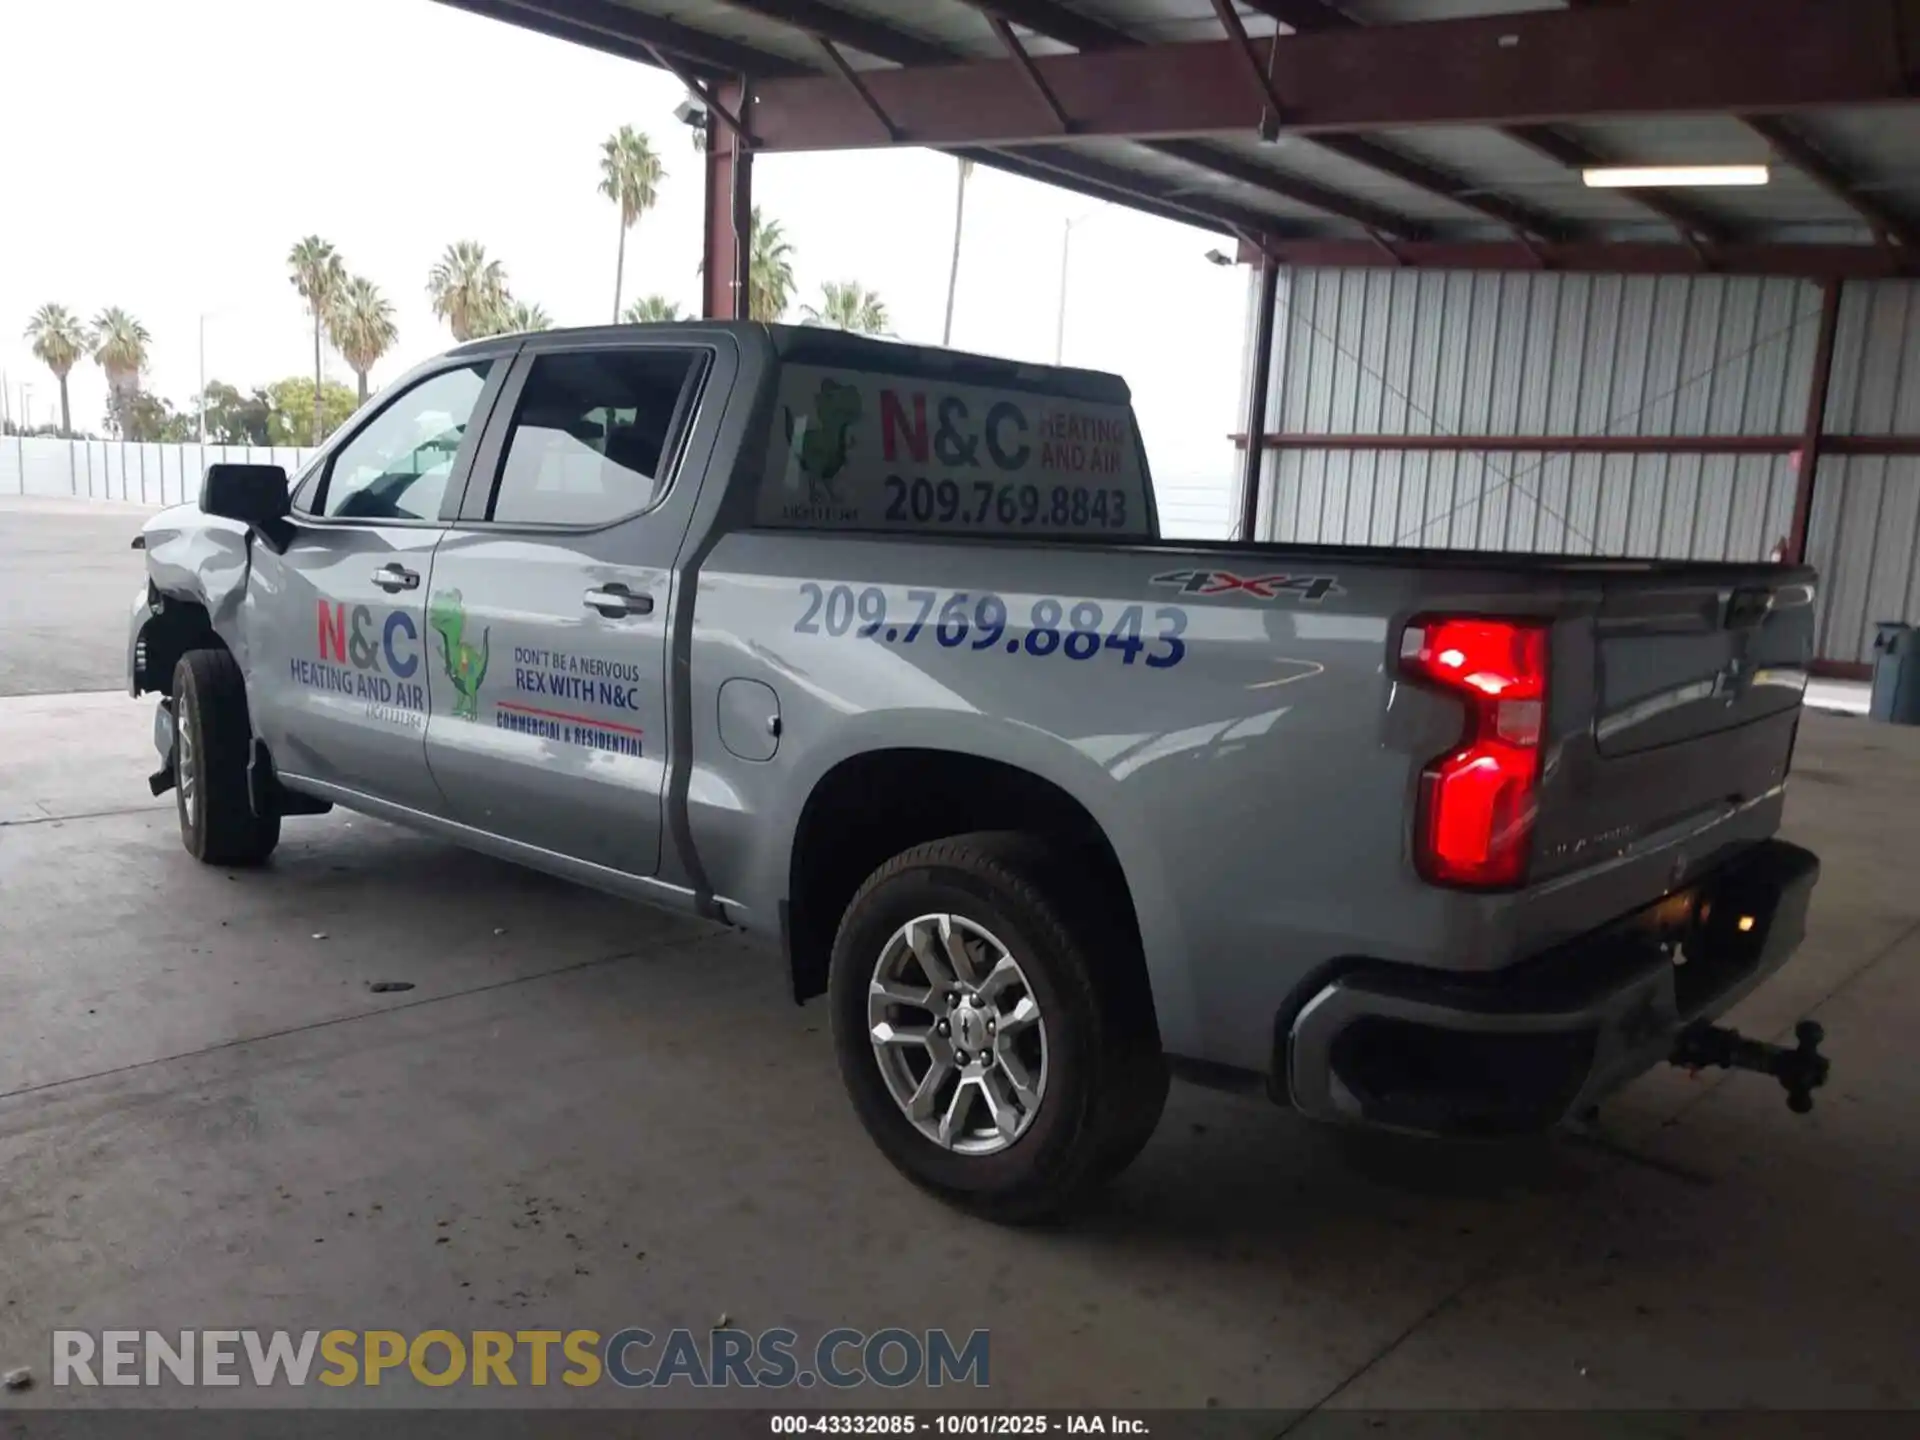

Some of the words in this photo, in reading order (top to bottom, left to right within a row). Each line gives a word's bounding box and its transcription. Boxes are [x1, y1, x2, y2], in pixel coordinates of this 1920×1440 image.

[878, 389, 1031, 470] N&C
[1040, 411, 1124, 444] HEATING
[1041, 441, 1084, 472] AND
[1089, 444, 1121, 474] AIR
[883, 476, 1126, 528] 209.769.8843
[317, 599, 418, 678] N&C
[793, 582, 1188, 668] 209.769.8843
[290, 658, 353, 695] HEATING
[356, 679, 392, 705] AND
[391, 682, 424, 712] AIR
[514, 647, 550, 667] DON'T
[552, 652, 567, 671] BE
[569, 655, 578, 673] A
[580, 657, 640, 682] NERVOUS
[515, 668, 546, 695] REX
[549, 674, 595, 703] WITH
[599, 683, 640, 711] N&C
[496, 710, 561, 741] COMMERCIAL
[564, 727, 572, 743] &
[574, 726, 643, 758] RESIDENTIAL
